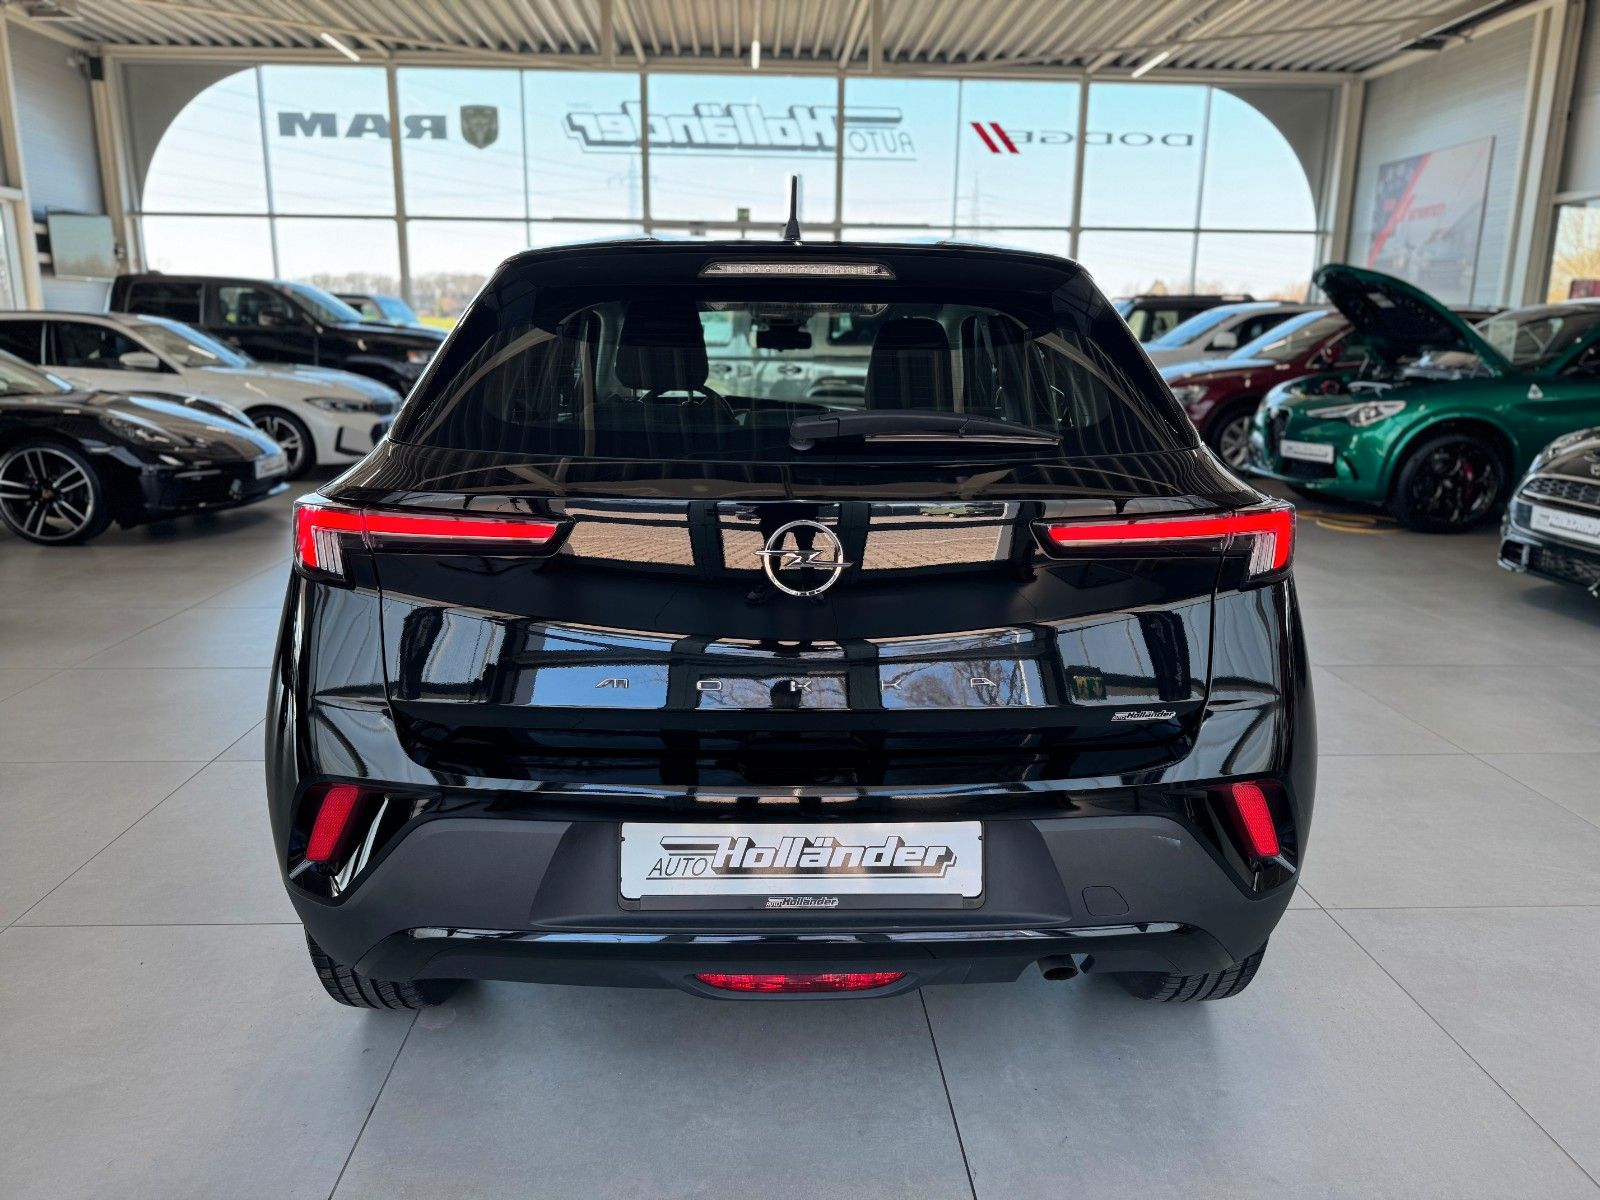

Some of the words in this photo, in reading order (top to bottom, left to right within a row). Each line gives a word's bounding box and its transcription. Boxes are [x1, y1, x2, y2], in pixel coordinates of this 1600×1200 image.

[648, 857, 708, 877] AUTO
[711, 836, 955, 875] Holländer
[781, 896, 839, 907] Holländer
